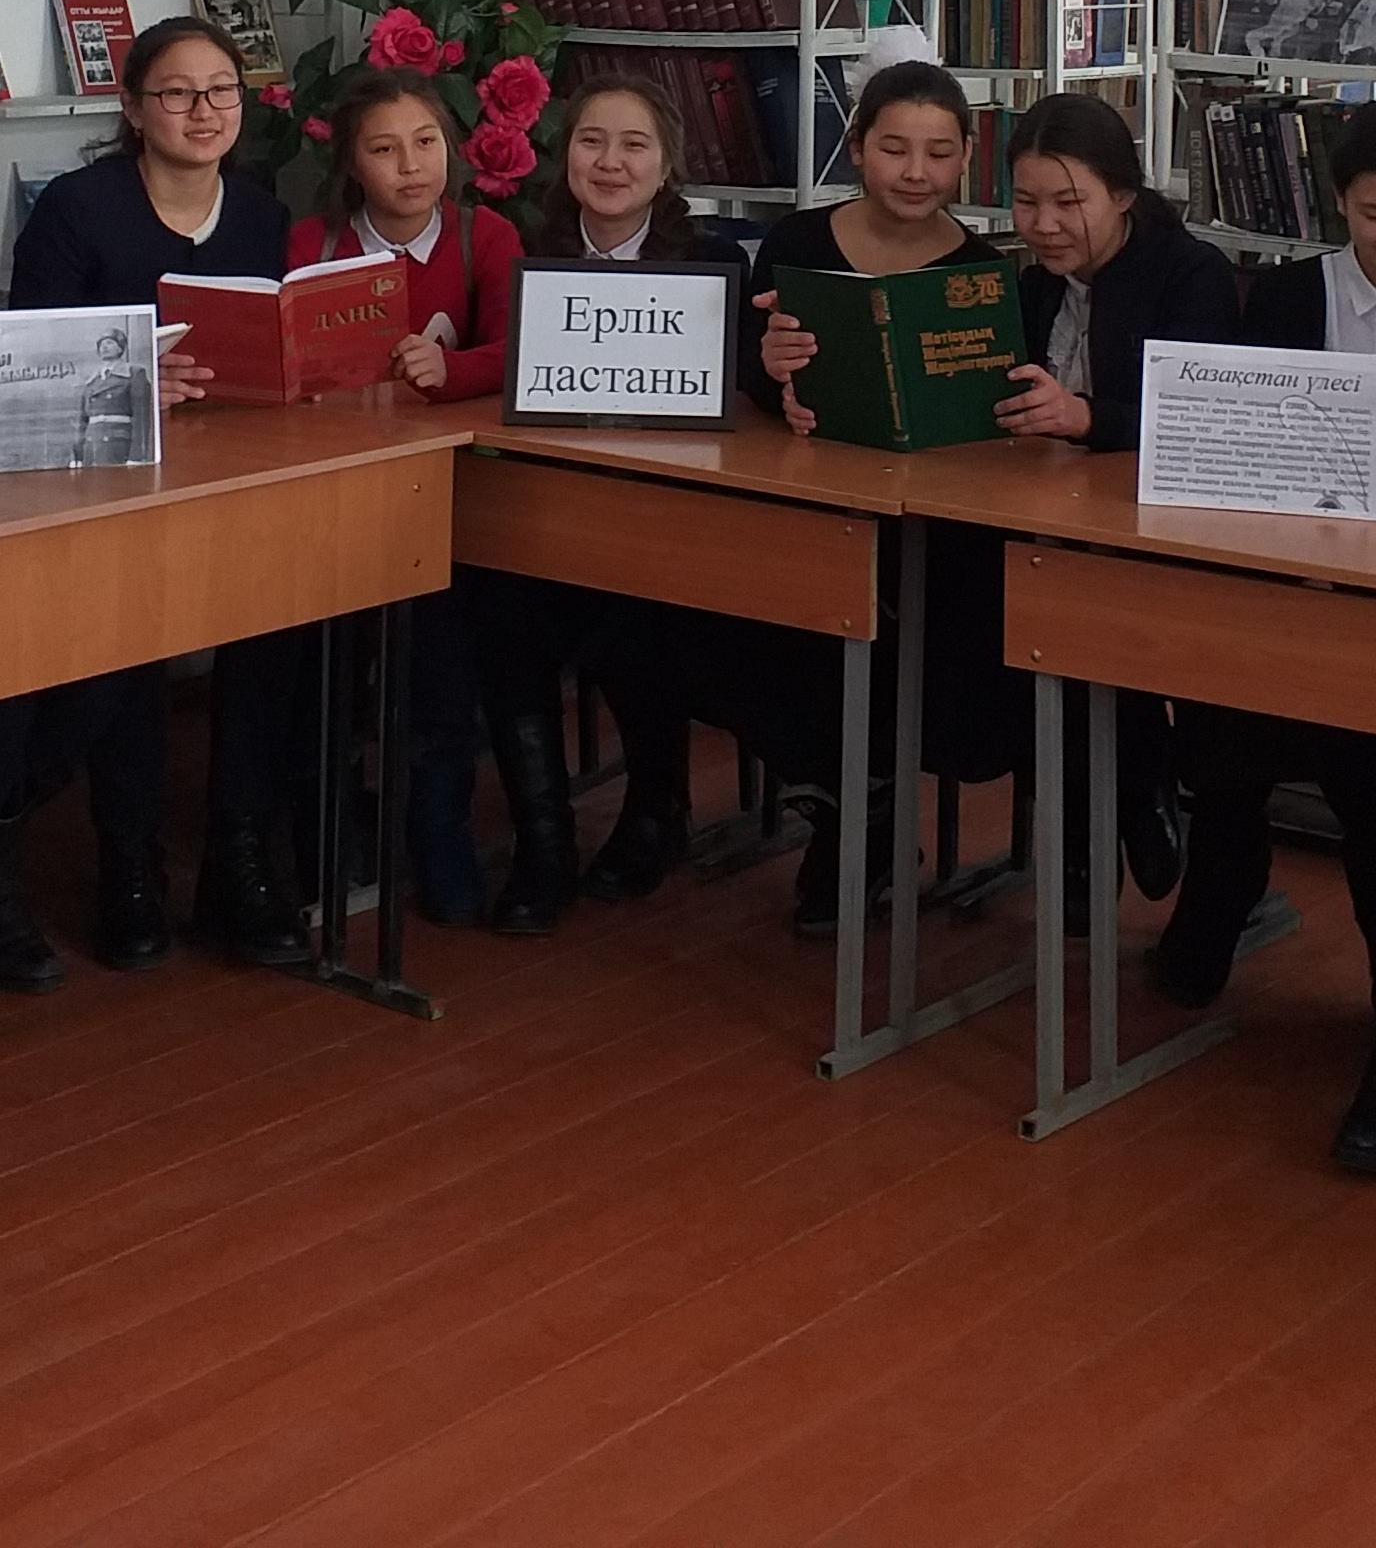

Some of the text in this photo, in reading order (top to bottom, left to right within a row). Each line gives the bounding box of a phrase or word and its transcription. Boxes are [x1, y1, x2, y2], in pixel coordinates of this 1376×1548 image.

[560, 296, 685, 344] Ерлік
[527, 365, 711, 397] дастаны
[1178, 360, 1362, 394] Қазақстан үлесі
